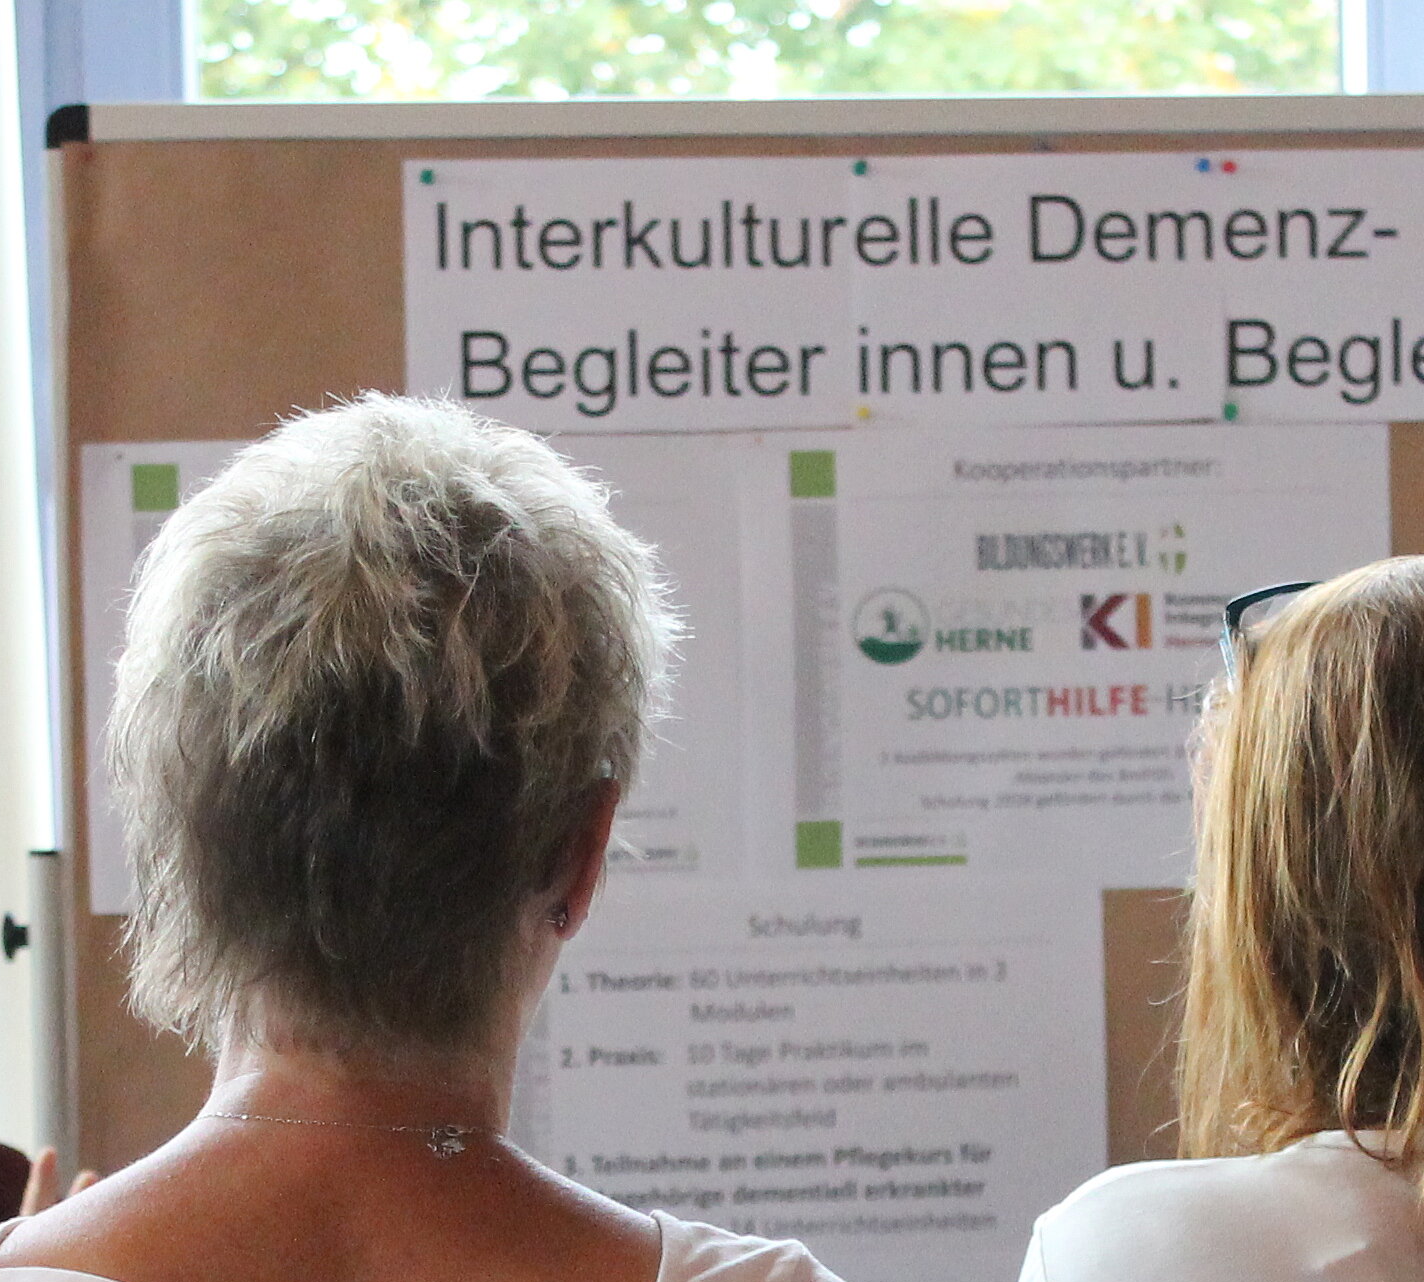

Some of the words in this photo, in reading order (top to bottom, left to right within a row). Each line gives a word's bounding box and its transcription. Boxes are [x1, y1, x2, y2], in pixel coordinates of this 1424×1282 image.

[436, 197, 996, 272] Interkulturelle
[1029, 192, 1401, 265] Demenz-
[459, 328, 828, 416] Begleiter
[859, 325, 1079, 393] innen
[1113, 333, 1181, 390] u.
[954, 457, 1224, 483] Kooperationspartner:
[935, 626, 1034, 653] HERNE
[749, 914, 863, 940] Schulung
